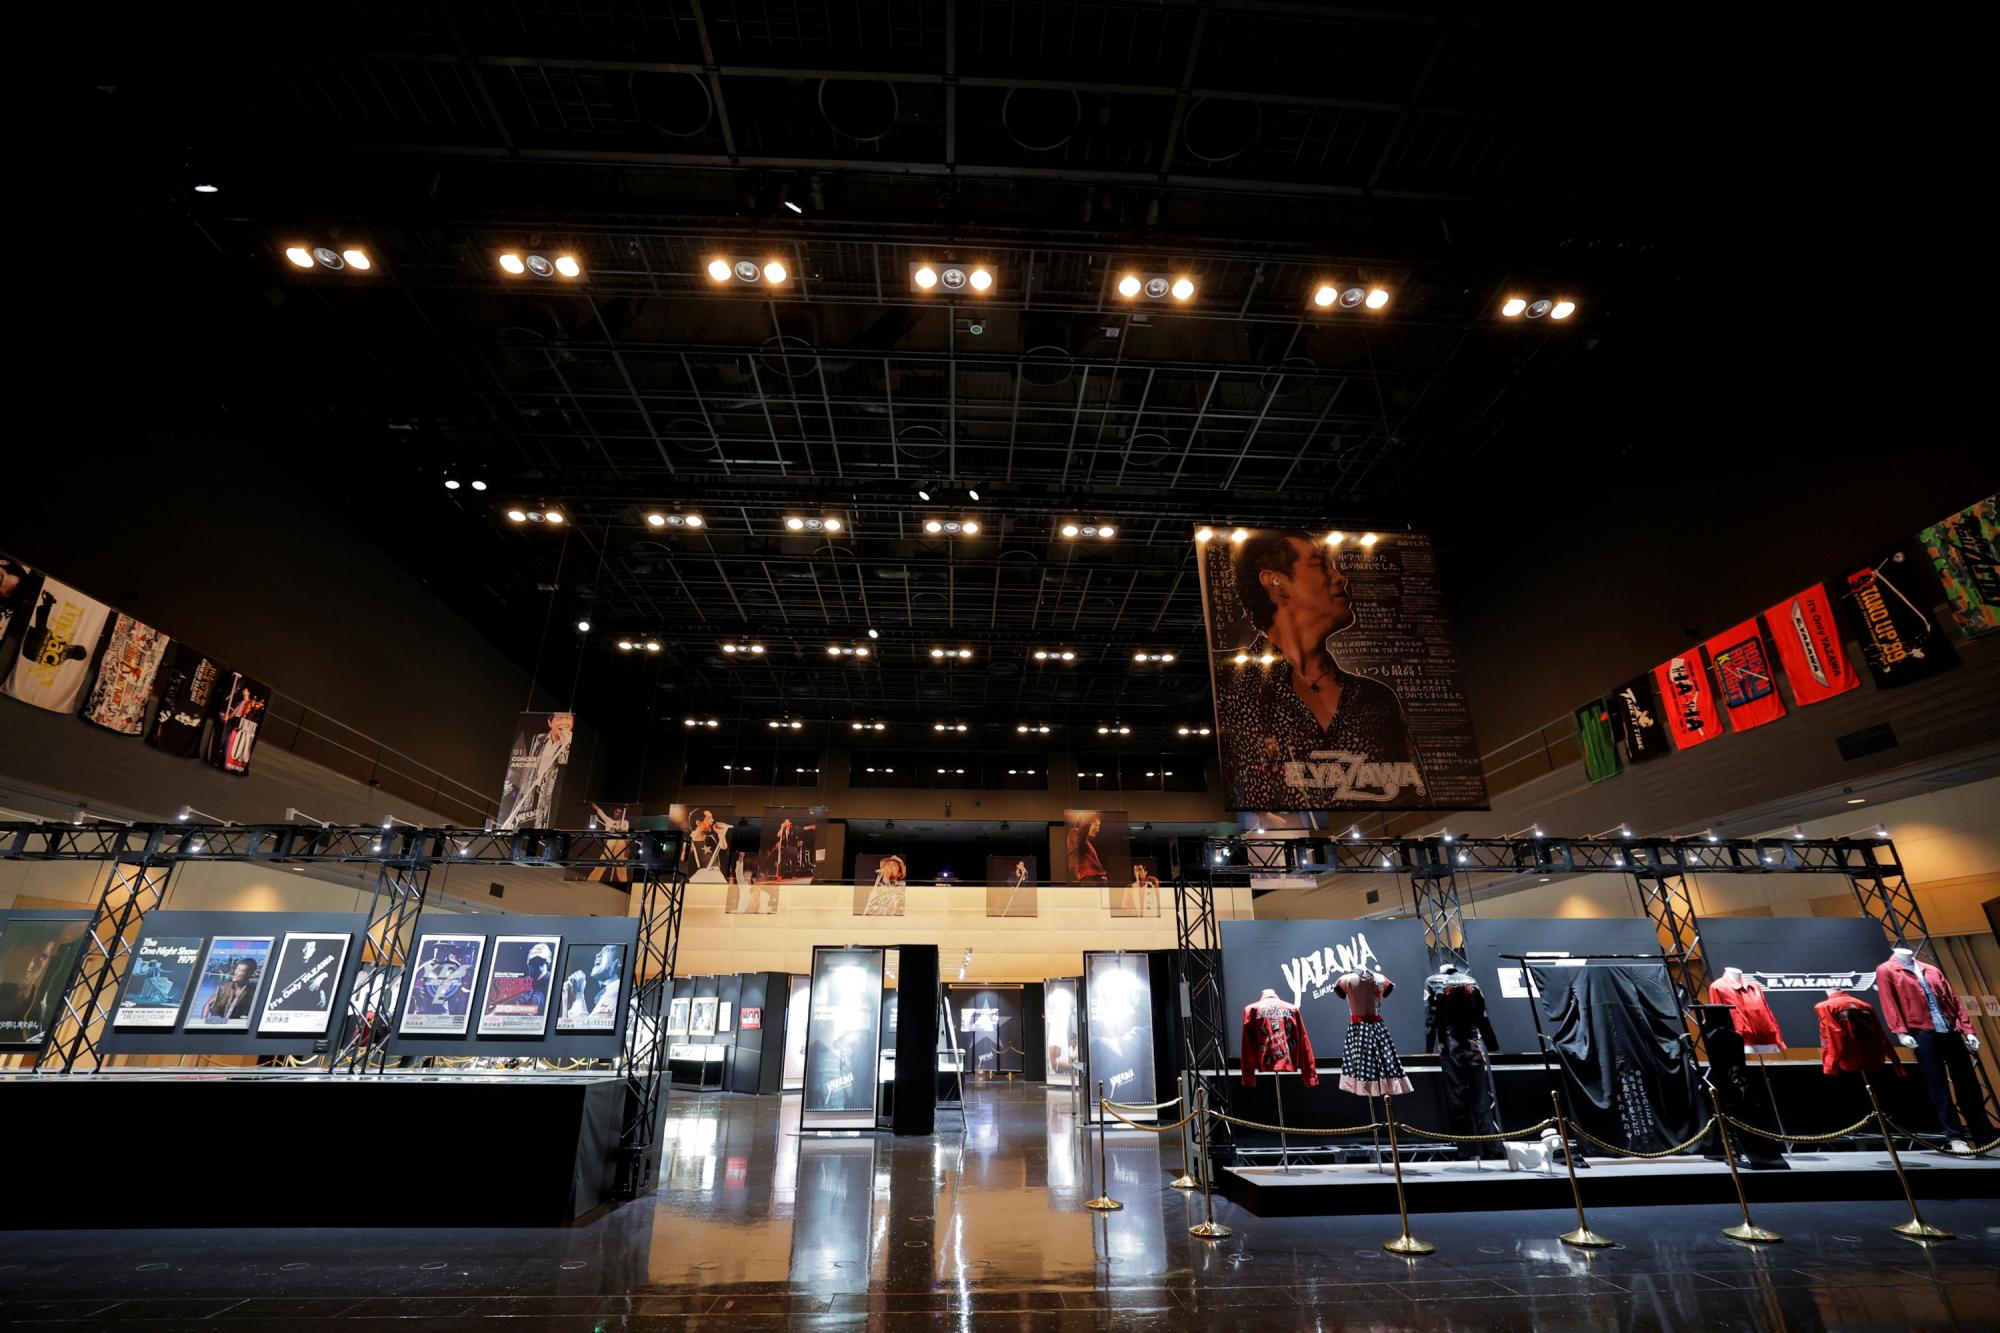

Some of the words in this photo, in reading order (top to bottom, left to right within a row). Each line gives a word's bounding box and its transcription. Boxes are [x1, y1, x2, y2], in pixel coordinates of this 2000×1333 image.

[1806, 599, 1818, 613] It's
[1812, 613, 1827, 636] Only
[1820, 636, 1842, 677] YAZAWA
[1874, 620, 1896, 643] UP
[143, 938, 158, 946] The
[140, 947, 156, 955] One
[156, 947, 177, 957] Night
[177, 947, 200, 956] Show
[177, 956, 197, 964] 1979
[283, 982, 302, 999] Only
